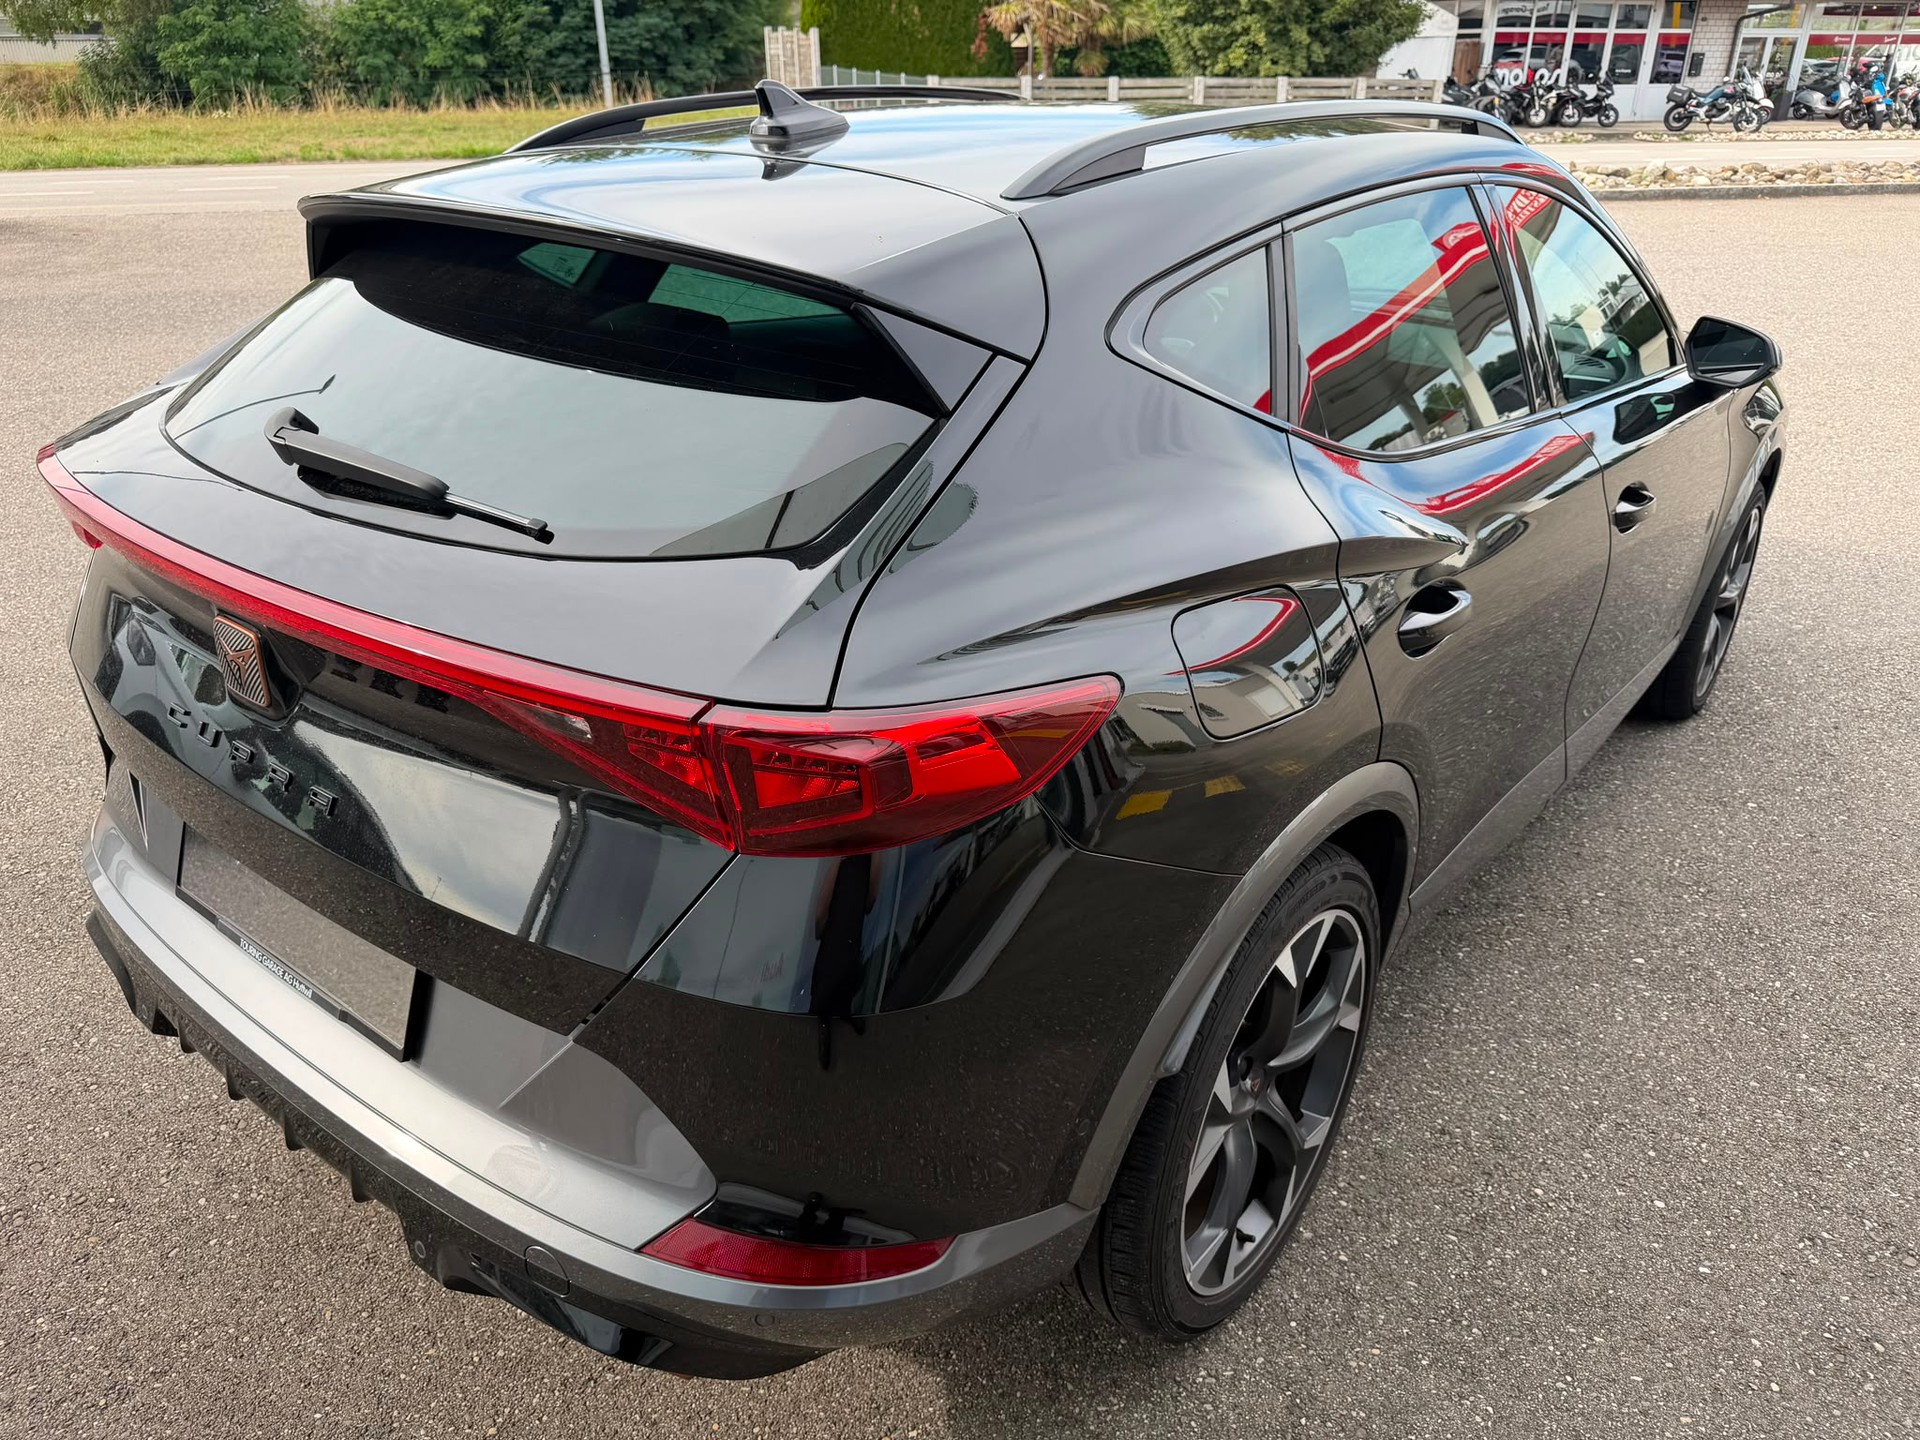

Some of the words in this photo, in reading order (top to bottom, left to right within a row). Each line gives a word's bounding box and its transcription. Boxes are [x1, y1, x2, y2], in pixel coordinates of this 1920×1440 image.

[167, 702, 338, 818] CUPRA
[240, 938, 262, 961] TOURING
[262, 956, 284, 978] GARAGE
[283, 972, 293, 984] AG
